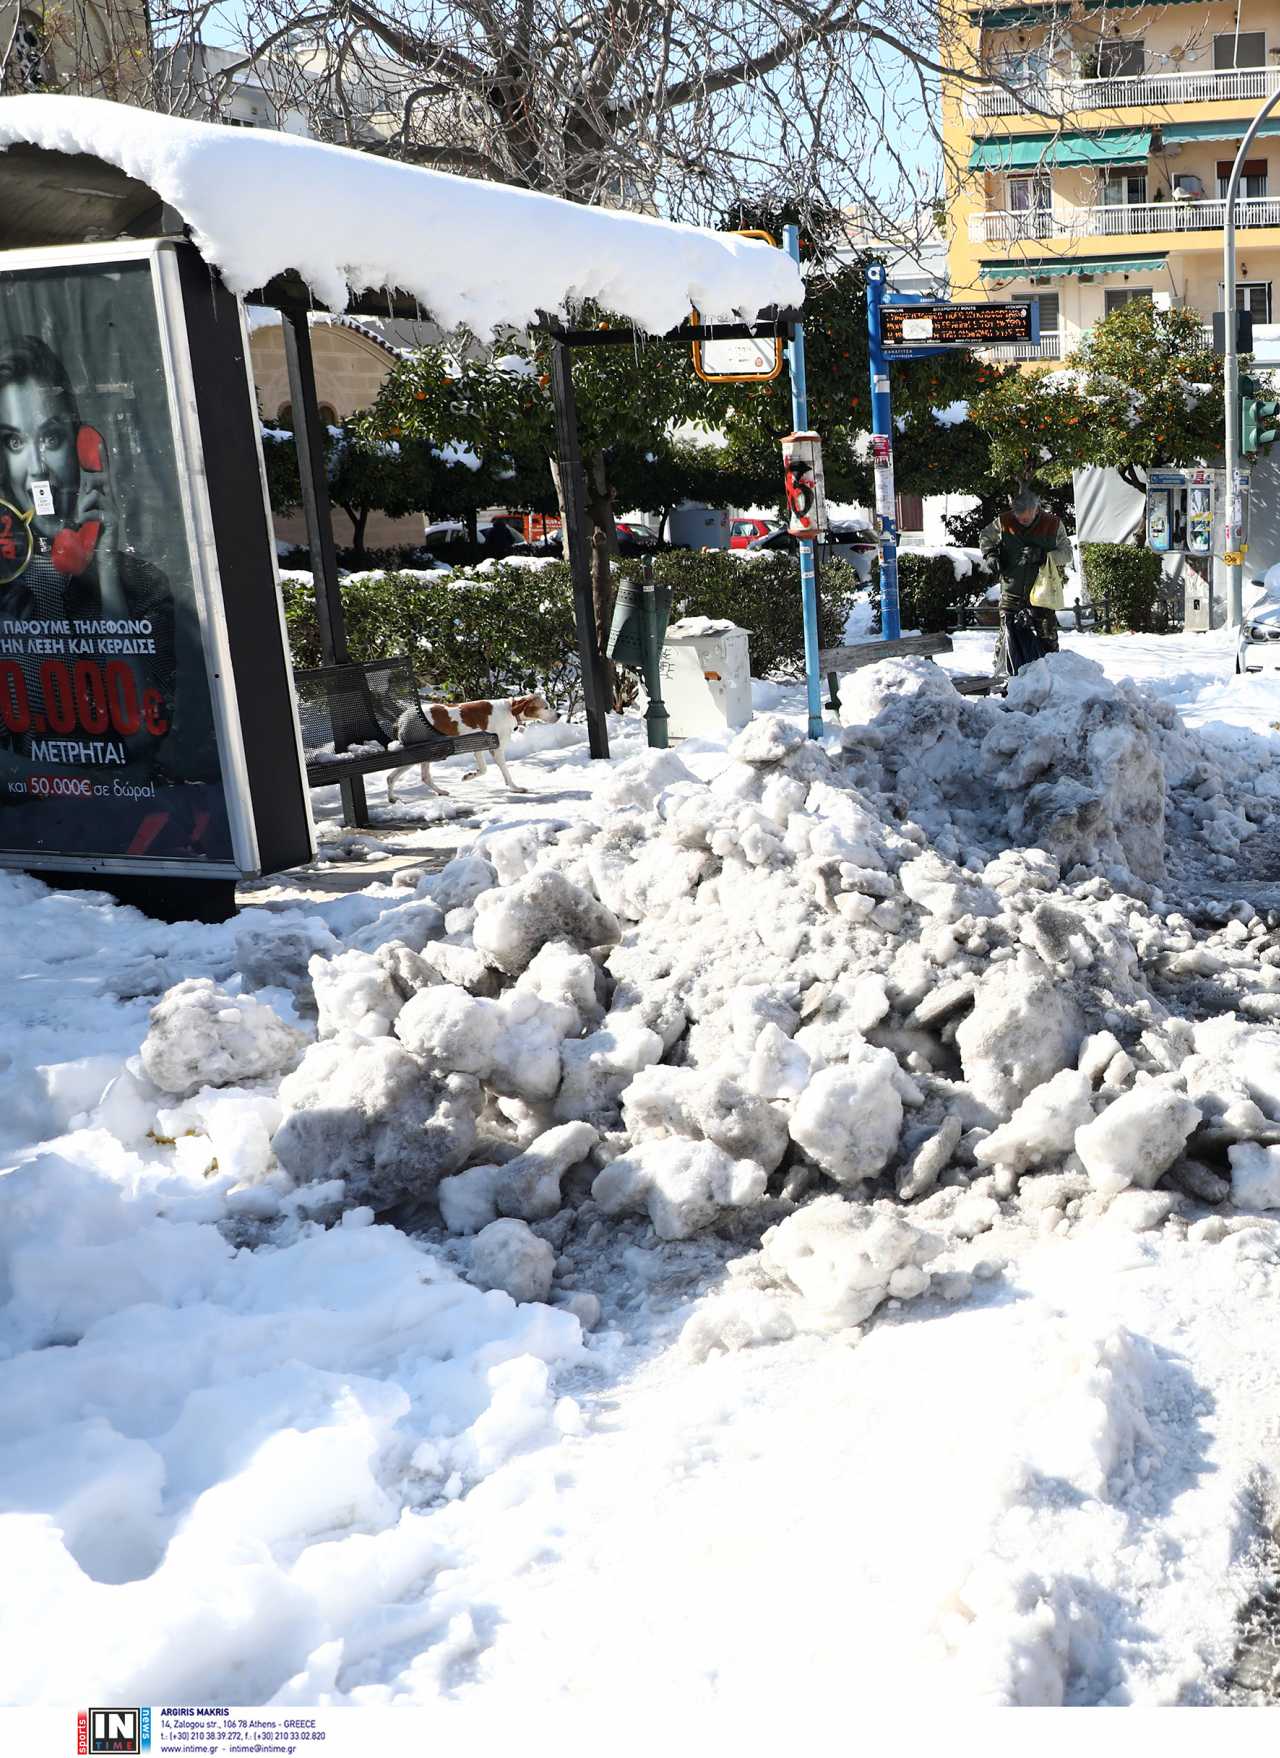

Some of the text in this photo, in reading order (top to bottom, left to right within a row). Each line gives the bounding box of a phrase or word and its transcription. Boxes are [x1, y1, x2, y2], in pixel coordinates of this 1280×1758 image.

[3, 619, 153, 636] ΠΑΡΟΥΜΕ ΤΗΛΕΦΩΝΟ
[27, 638, 64, 655] ΛΕΞΗ
[68, 638, 95, 655] ΚΑΙ
[97, 638, 157, 655] ΚΕΡΔΙΣΕ
[31, 740, 128, 765] ΜΕΤΡΗΤΑ!
[8, 776, 156, 802] και 50.000€ σε δώρα!
